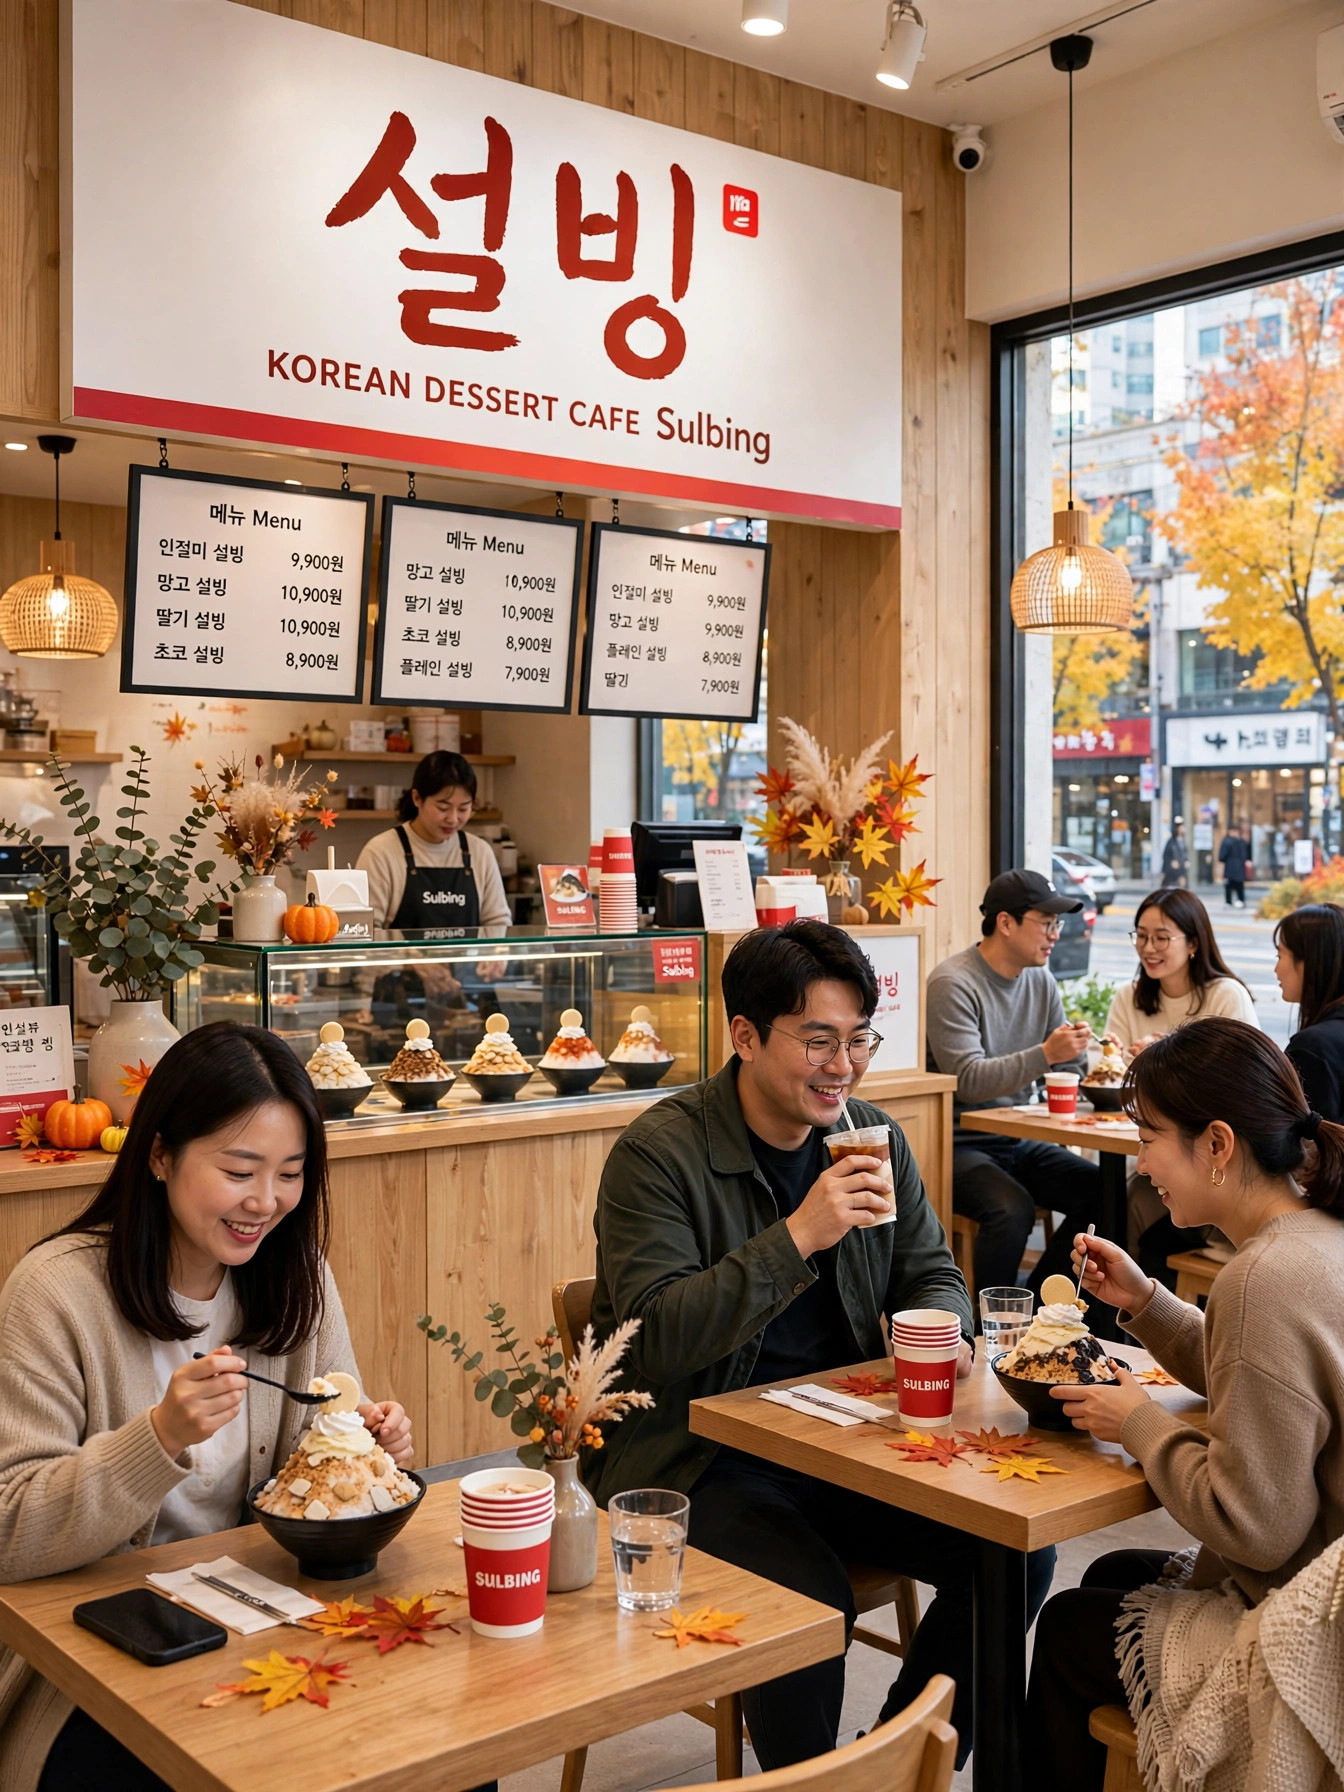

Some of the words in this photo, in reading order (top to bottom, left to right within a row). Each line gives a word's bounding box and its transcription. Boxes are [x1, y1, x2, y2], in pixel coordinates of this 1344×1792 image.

[325, 112, 694, 379] 설빙
[269, 350, 409, 398] KOREAN
[426, 376, 558, 421] DESSERT
[570, 401, 639, 435] CAFE
[657, 407, 770, 464] Sulbing
[210, 504, 245, 526] 메뉴
[253, 510, 301, 531] Menu
[160, 539, 206, 560] 인절미
[214, 544, 243, 563] 설빙
[292, 553, 343, 572] 9,900원
[447, 531, 477, 551] 메뉴
[483, 536, 524, 554] Menu
[650, 554, 676, 572] 메뉴
[682, 558, 716, 575] Menu
[158, 574, 190, 592] 망고
[196, 578, 226, 596] 설빙
[282, 586, 341, 605] 10,900원
[407, 564, 433, 580] 망고
[439, 567, 464, 584] 설빙
[506, 575, 555, 592] 10,900원
[405, 596, 430, 613] 딸기
[437, 599, 462, 616] 설빙
[503, 605, 553, 623] 10,900원
[612, 584, 646, 600] 인절미
[652, 589, 672, 604] 설빙
[708, 595, 745, 611] 9,900원
[157, 608, 187, 628] 딸기
[195, 612, 224, 630] 설빙
[281, 619, 339, 638] 10,900원
[610, 613, 632, 628] 망고
[637, 616, 658, 631] 설빙
[705, 623, 743, 638] 9,900원
[402, 627, 429, 642] 초코
[436, 630, 460, 646] 설빙
[506, 636, 551, 653] 8,900원
[154, 643, 187, 660] 초코
[194, 646, 223, 664] 설빙
[286, 653, 338, 670] 8,900원
[607, 643, 641, 659] 플레인
[647, 646, 666, 661] 설빙
[703, 651, 741, 666] 8,900원
[400, 659, 440, 676] 플레인
[447, 662, 472, 678] 설빙
[506, 666, 550, 682] 7,900원
[702, 679, 739, 694] 7,900원
[423, 892, 465, 906] Sulbing
[904, 1379, 949, 1390] SULBING
[476, 1569, 540, 1588] SULBING
